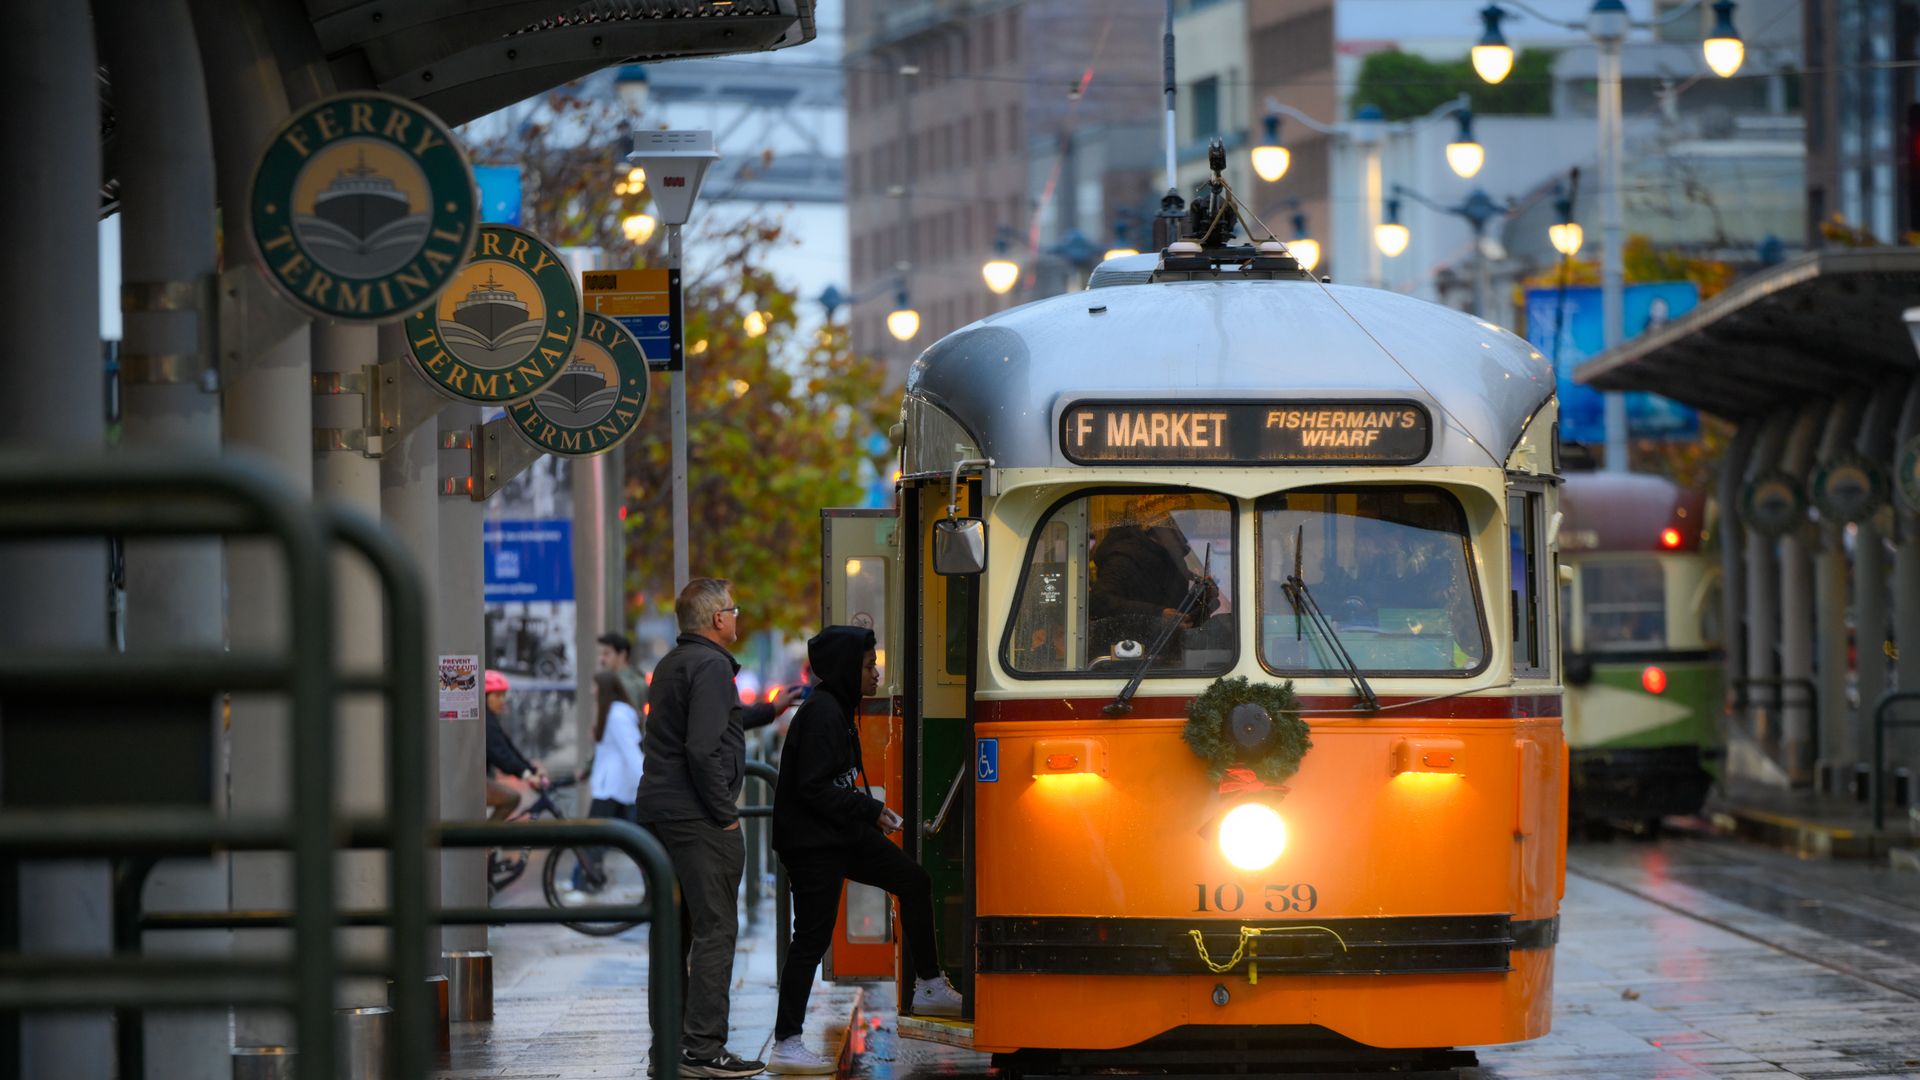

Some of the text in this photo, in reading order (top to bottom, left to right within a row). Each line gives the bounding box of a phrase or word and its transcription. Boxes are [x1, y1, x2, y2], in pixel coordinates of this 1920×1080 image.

[285, 102, 444, 159] FERRY
[264, 221, 466, 313] TERMINAL
[469, 232, 558, 275] RRY
[413, 324, 572, 397] TERMINAL
[514, 391, 641, 450] TERMINAL
[1076, 412, 1227, 447] F MARKET
[1301, 430, 1379, 447] WHARF
